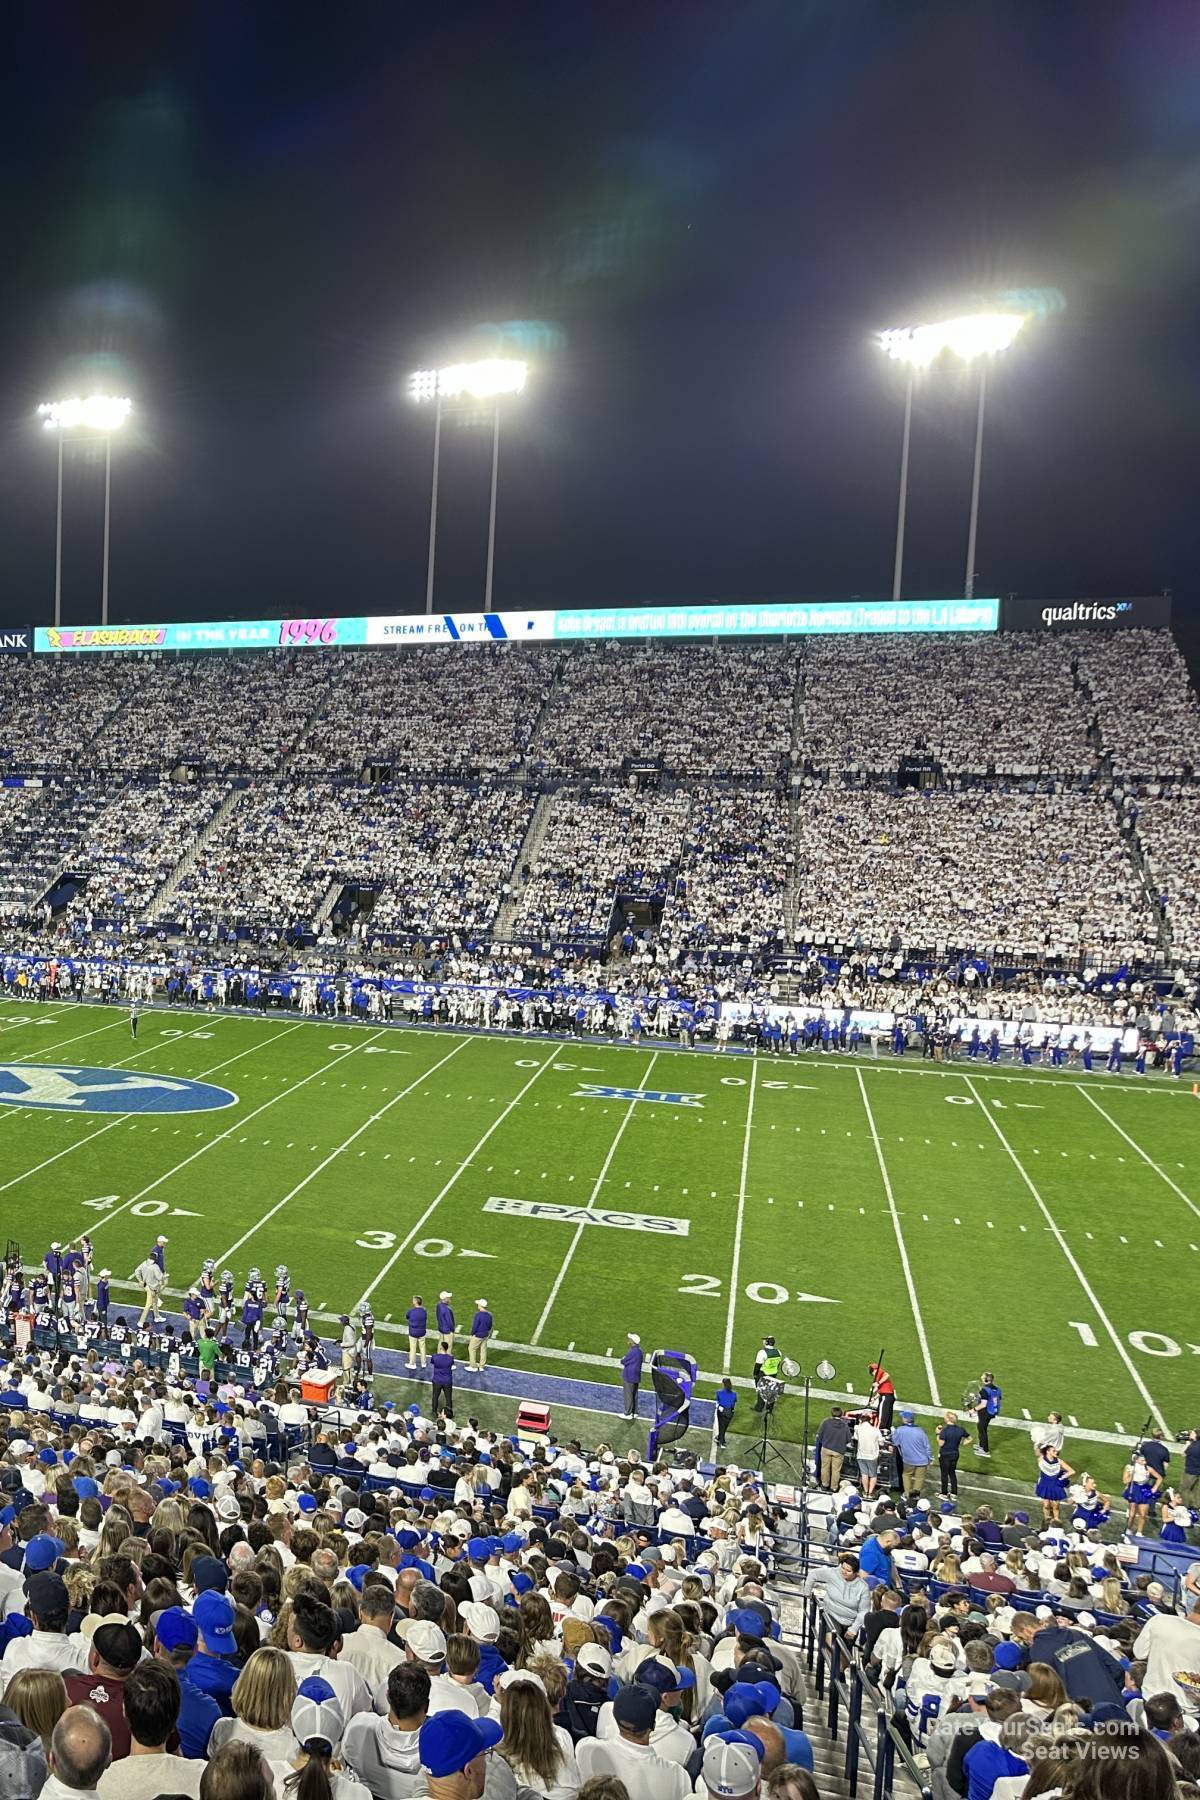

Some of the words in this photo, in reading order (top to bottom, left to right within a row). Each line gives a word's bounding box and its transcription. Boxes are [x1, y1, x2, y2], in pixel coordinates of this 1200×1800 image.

[1040, 602, 1116, 627] qualtrics
[71, 629, 162, 647] FLASHBACK
[278, 619, 337, 646] 1996
[383, 623, 425, 635] STREAM
[460, 622, 474, 632] ON
[81, 1194, 170, 1218] 40
[529, 1204, 680, 1233] PACS
[354, 1230, 455, 1258] 30
[677, 1273, 790, 1305] 20
[85, 1326, 100, 1339] 57
[111, 1328, 125, 1341] 26
[1068, 1320, 1184, 1358] 10
[236, 1353, 251, 1368] 19
[259, 1356, 273, 1372] 21
